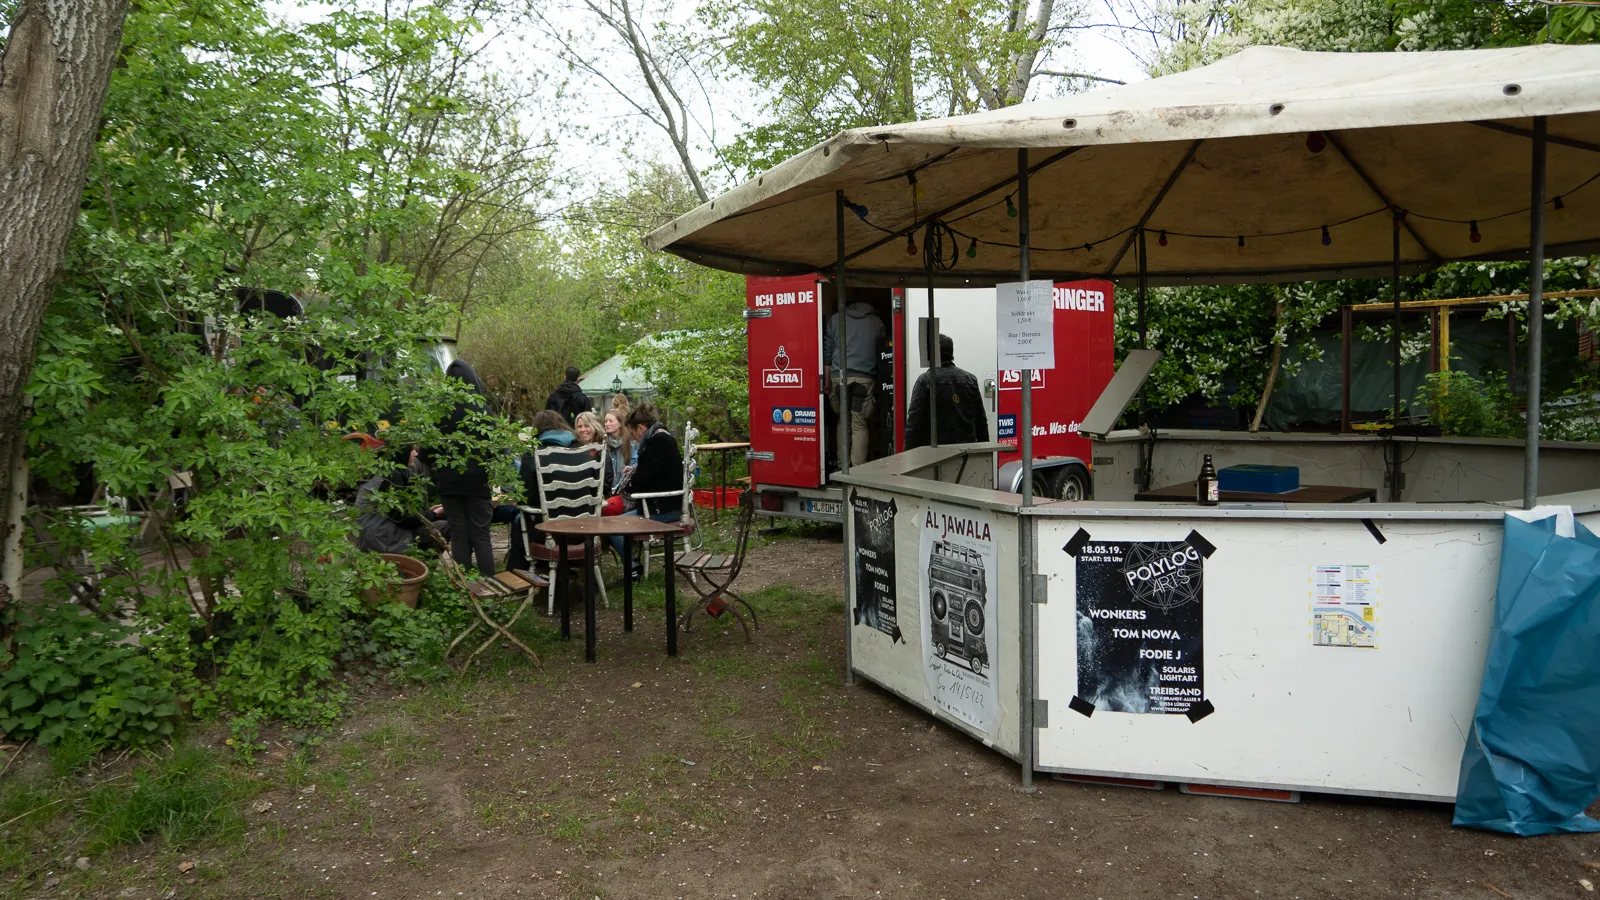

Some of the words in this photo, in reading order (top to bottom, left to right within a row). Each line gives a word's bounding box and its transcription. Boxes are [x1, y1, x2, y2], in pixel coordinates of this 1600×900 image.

[755, 294, 774, 307] ICH
[776, 292, 796, 305] BIN
[798, 290, 814, 304] DE
[1053, 287, 1105, 312] RINGER
[766, 373, 799, 383] ASTRA
[1002, 369, 1042, 383] ASA
[1031, 425, 1047, 437] tra.
[1049, 421, 1067, 435] Was
[942, 513, 992, 542] JAWALA
[1081, 545, 1123, 554] 18.05.19.
[1126, 545, 1199, 586] POLYLOG
[1152, 568, 1191, 597] ARTS
[1089, 609, 1147, 620] WONKERS
[1112, 628, 1139, 639] TOM
[1141, 629, 1181, 640] NOWA
[1140, 649, 1173, 660] FODIE
[1176, 650, 1181, 660] J
[1162, 666, 1196, 674] SOLARIS
[1159, 674, 1198, 682] LIGHTART
[1149, 686, 1202, 696] TREIBSAND
